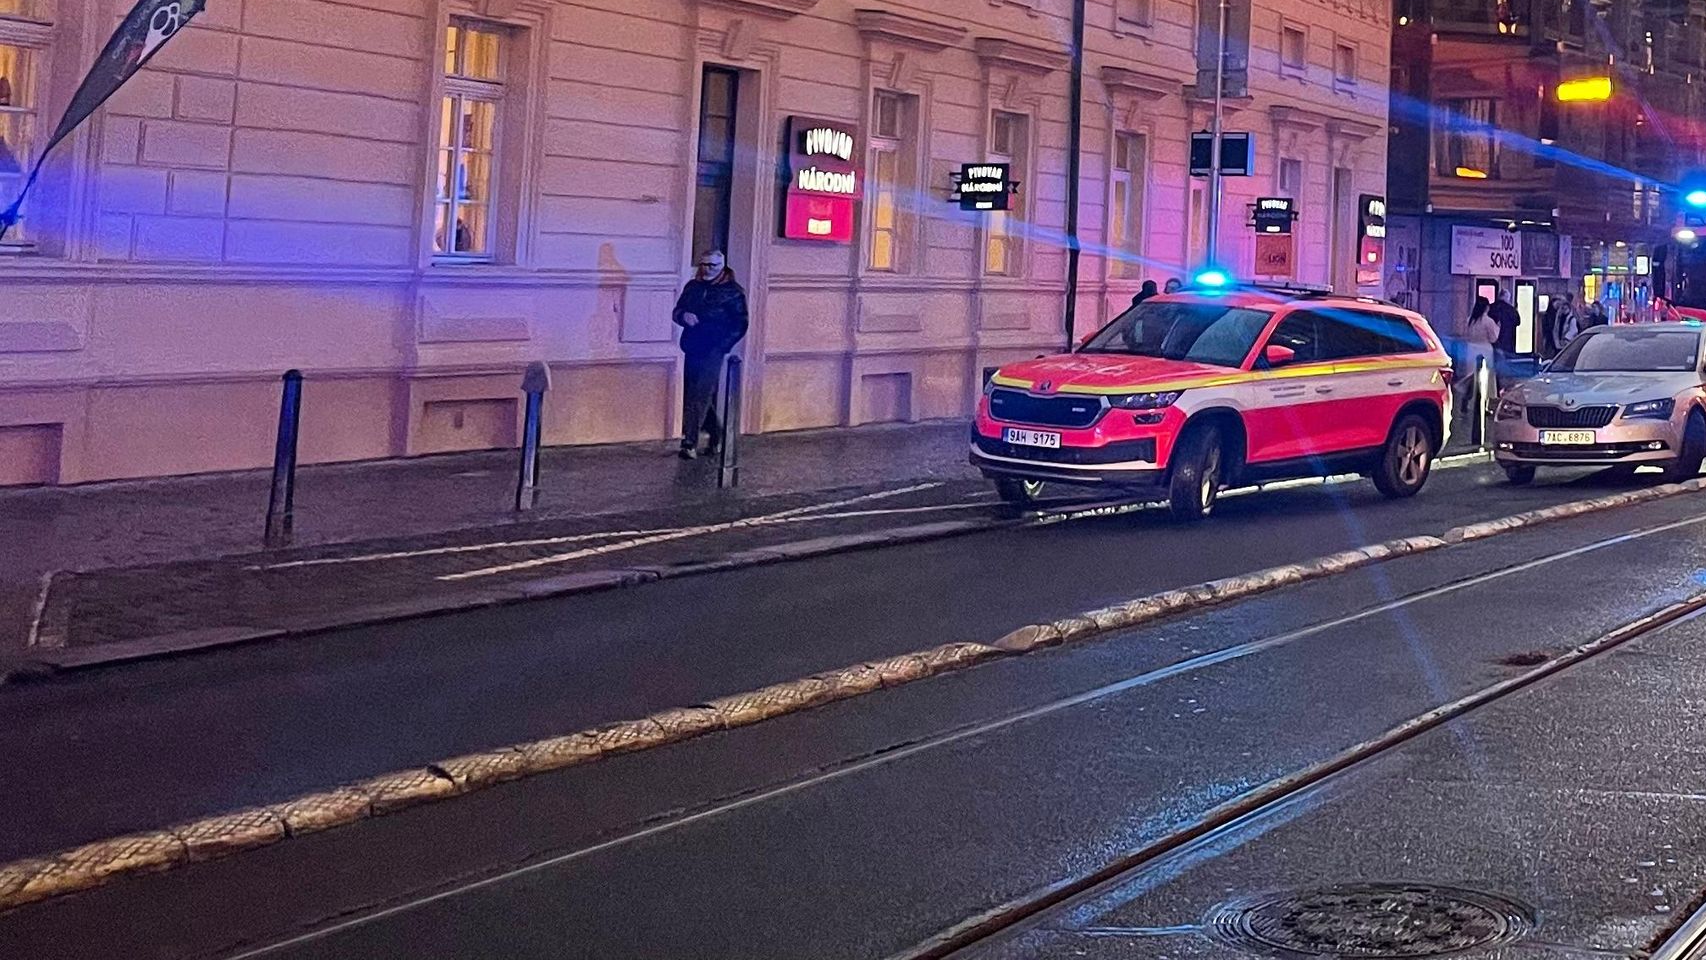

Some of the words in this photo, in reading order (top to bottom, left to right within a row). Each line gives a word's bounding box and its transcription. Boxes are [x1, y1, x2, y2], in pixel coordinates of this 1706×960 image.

[798, 166, 856, 194] NÁRODNÍ
[967, 166, 1003, 179] PIVOVAR
[1501, 235, 1514, 250] 100
[1010, 430, 1026, 443] 9AH
[1033, 432, 1056, 446] 9175
